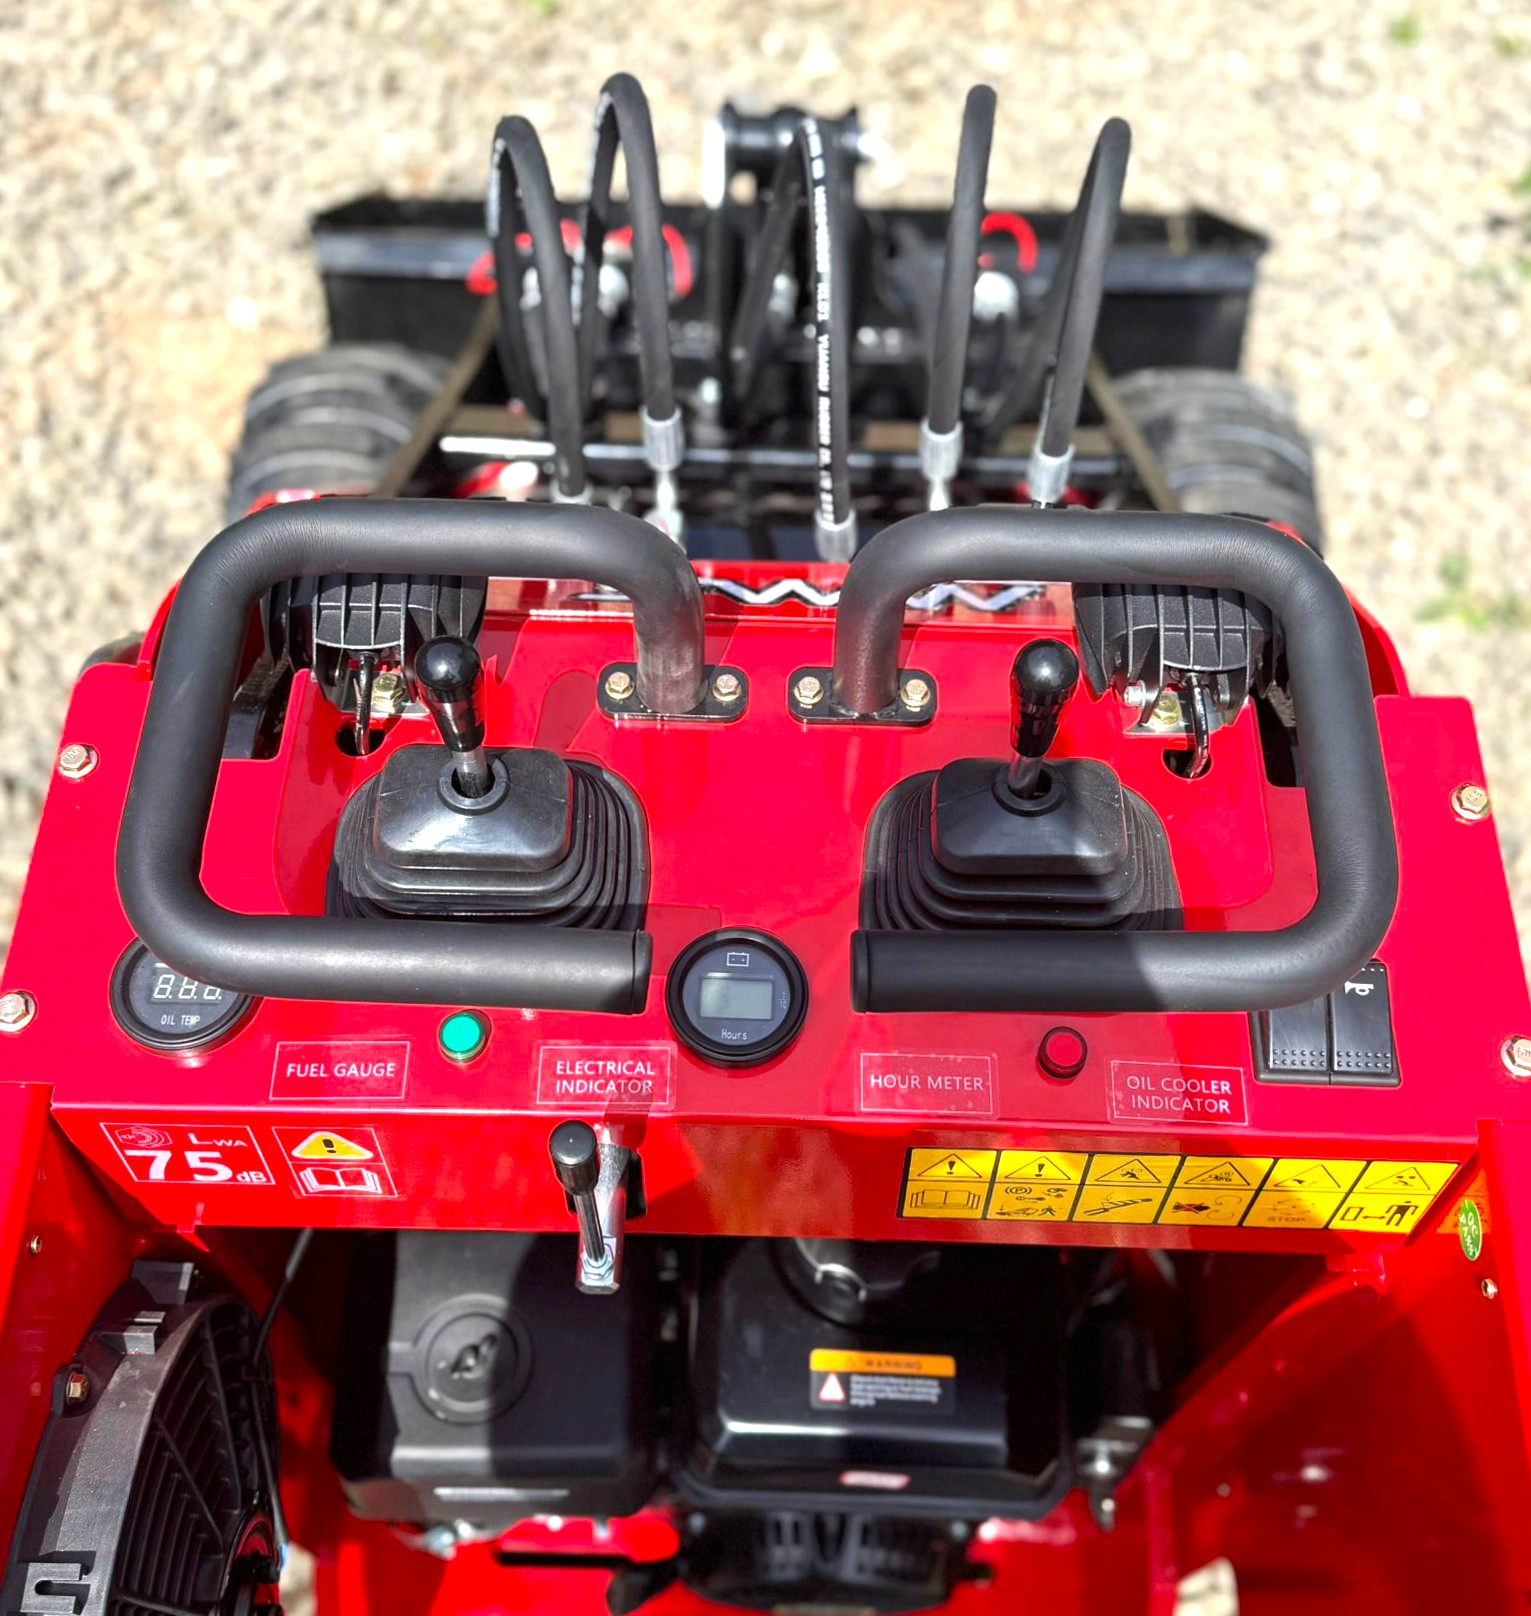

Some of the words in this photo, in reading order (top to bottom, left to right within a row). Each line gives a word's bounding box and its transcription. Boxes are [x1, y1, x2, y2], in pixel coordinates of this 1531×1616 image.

[160, 1014, 175, 1026] OIL
[180, 1014, 201, 1026] TEMP
[721, 1028, 747, 1041] Hours
[286, 1062, 328, 1078] FUEL
[333, 1062, 396, 1078] GAUGE
[555, 1060, 656, 1075] ELECTRICAL
[555, 1079, 653, 1094] INDICATOR
[869, 1073, 921, 1090] HOUR
[926, 1075, 984, 1092] METER
[1126, 1075, 1156, 1091] OIL
[1160, 1077, 1233, 1096] COOLER
[1131, 1094, 1231, 1114] INDICATOR
[1266, 1215, 1306, 1223] STOP
